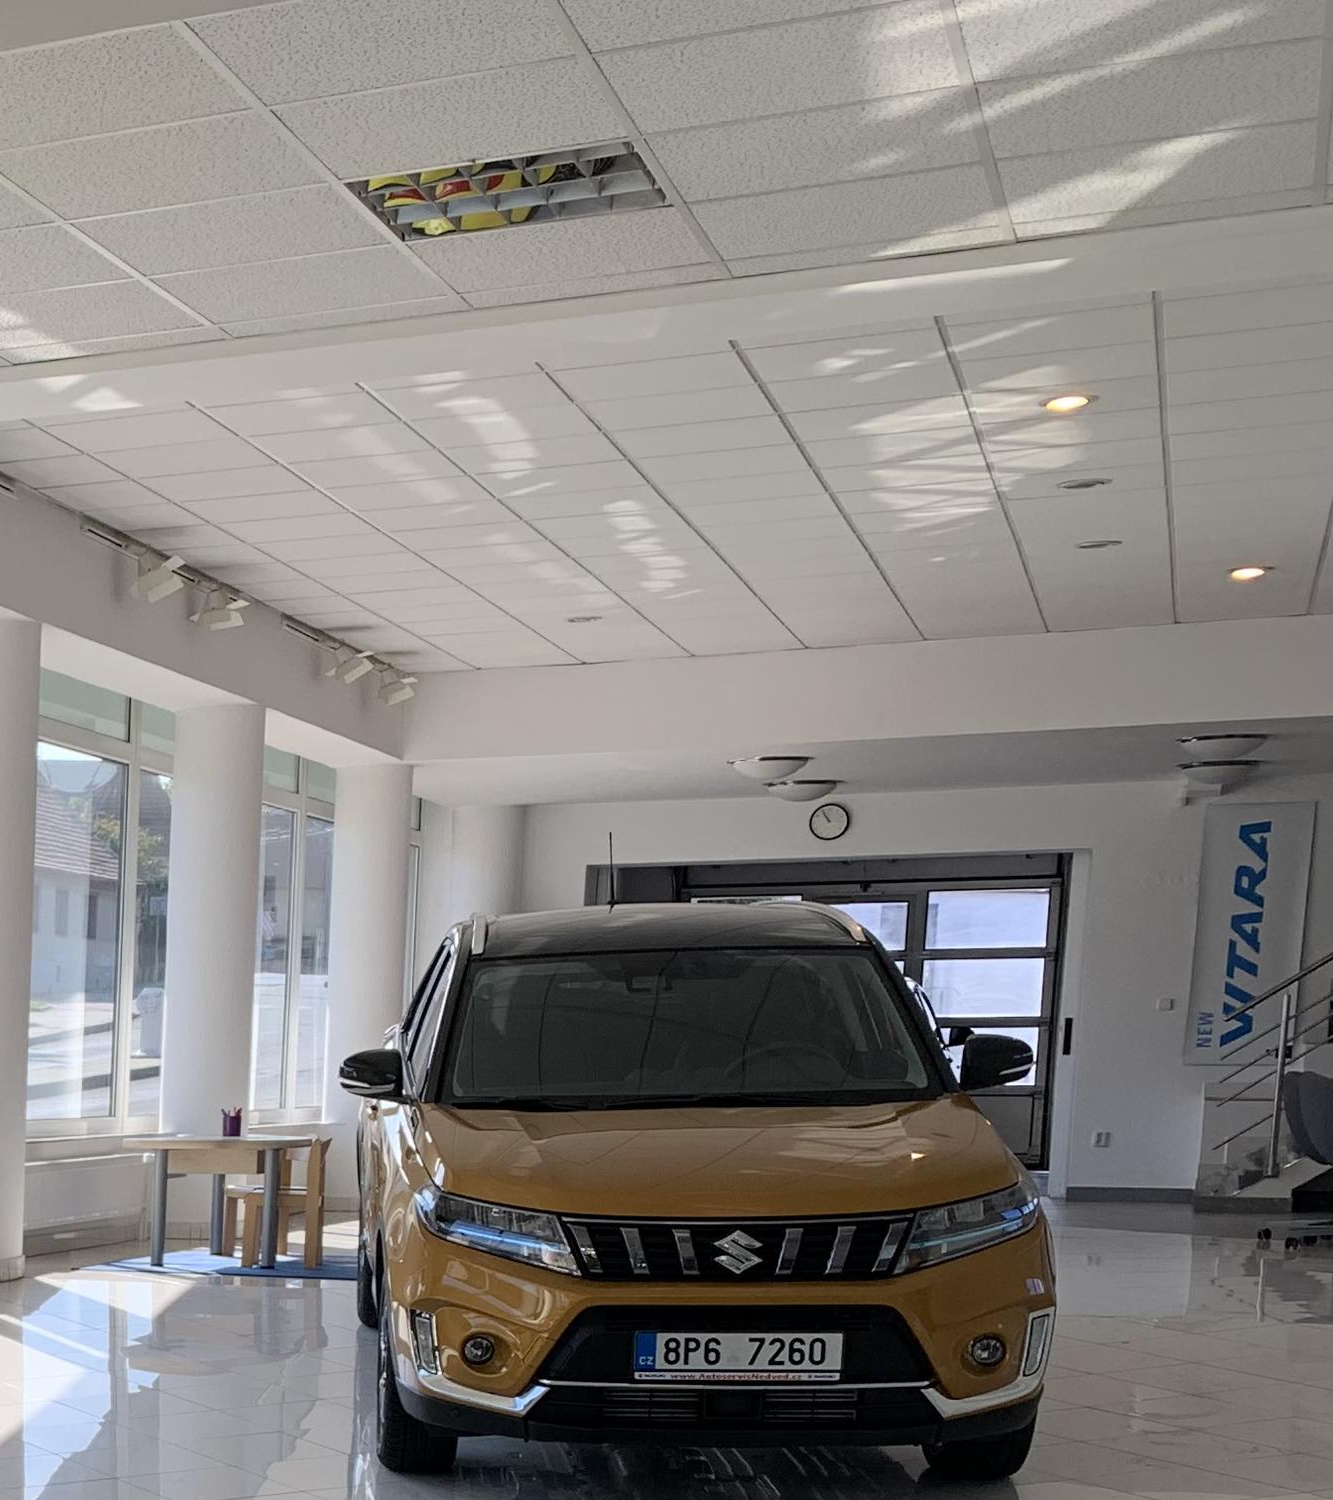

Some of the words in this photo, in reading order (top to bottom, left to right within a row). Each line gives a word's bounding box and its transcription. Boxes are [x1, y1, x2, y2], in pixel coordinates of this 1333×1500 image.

[1219, 820, 1273, 1048] VITARA
[1196, 1011, 1214, 1048] NEW
[638, 1356, 654, 1365] CZ
[663, 1337, 722, 1366] 8P6
[748, 1337, 827, 1366] 7260
